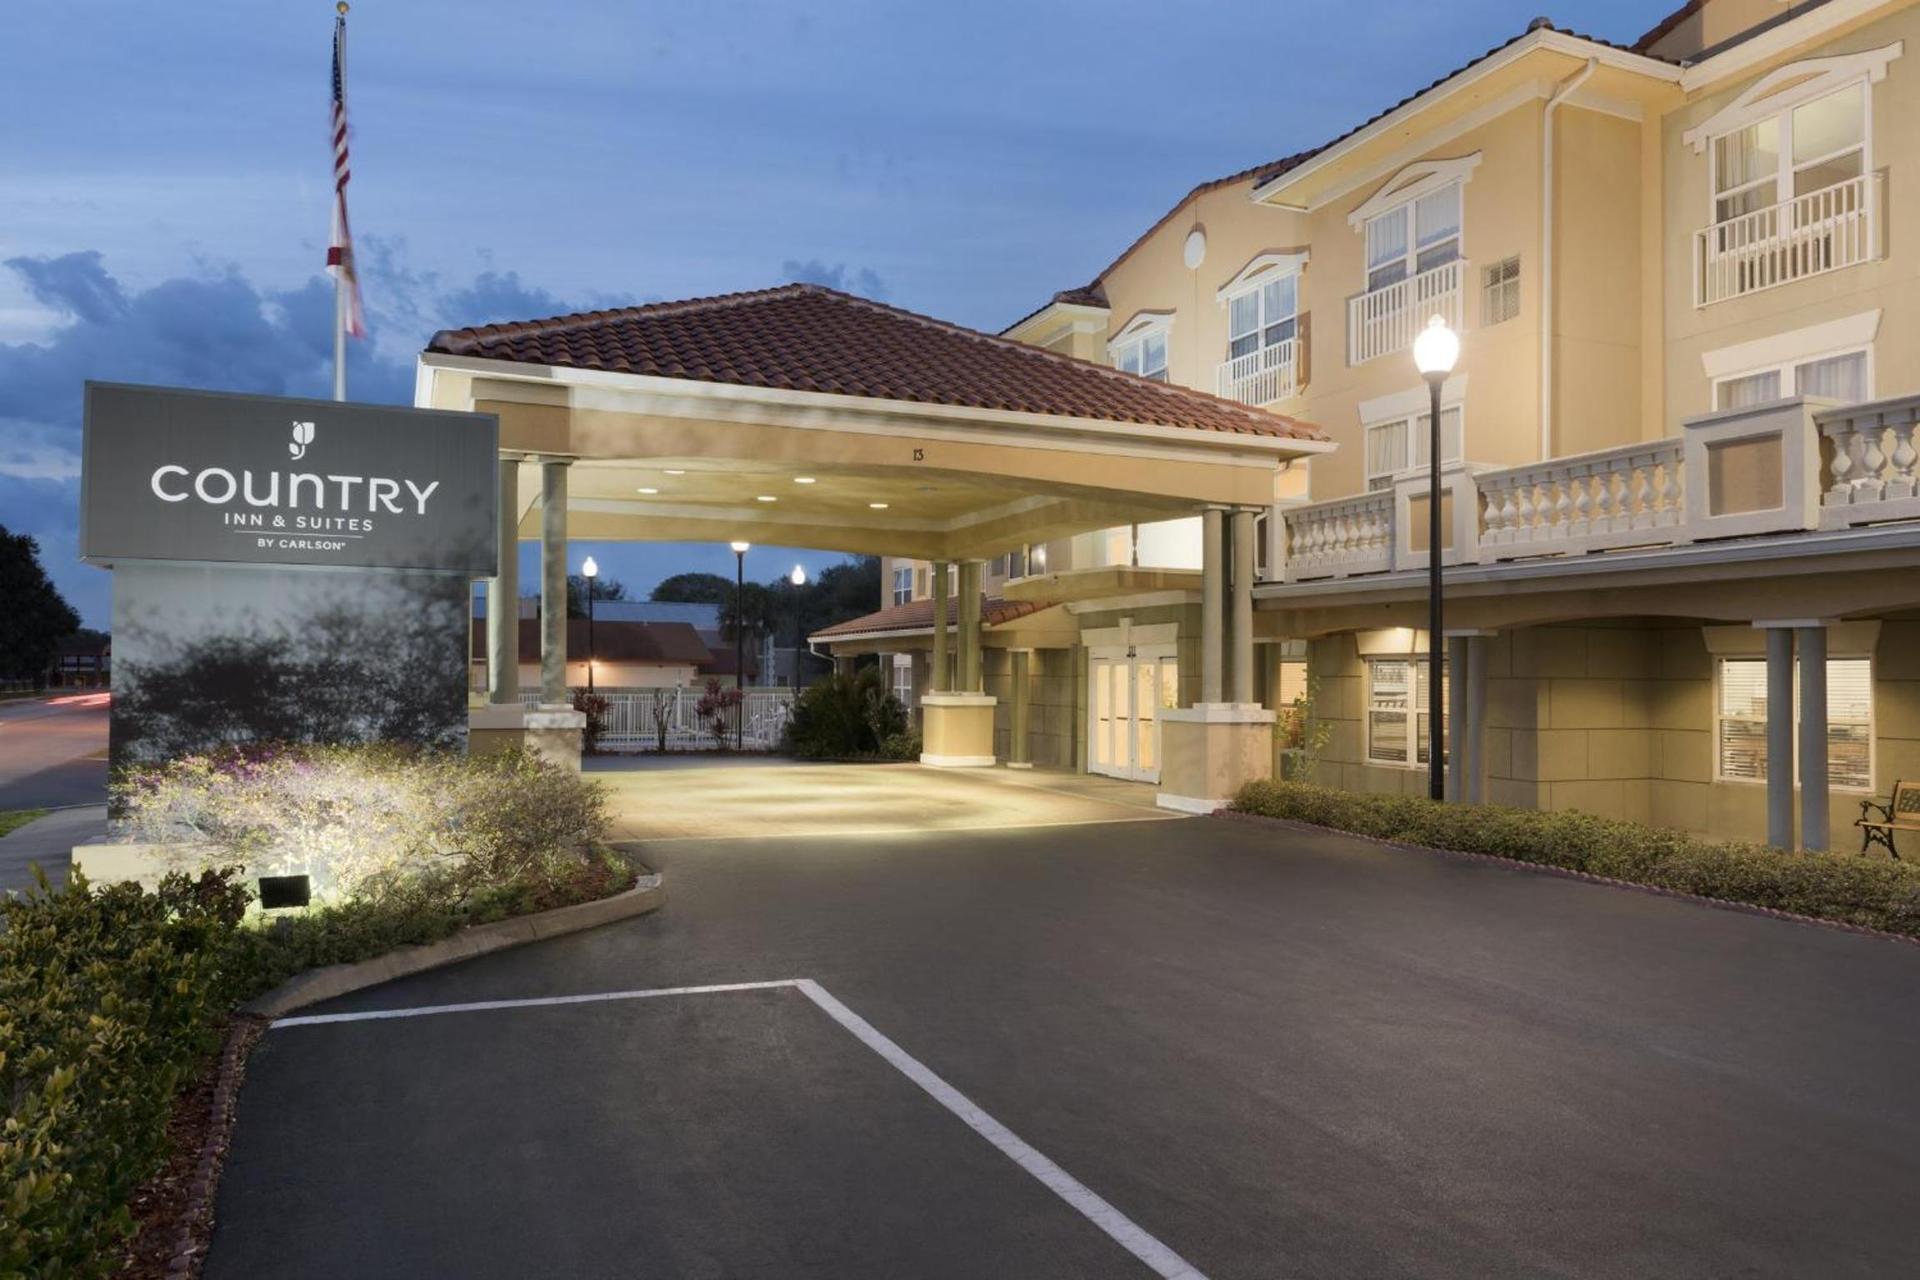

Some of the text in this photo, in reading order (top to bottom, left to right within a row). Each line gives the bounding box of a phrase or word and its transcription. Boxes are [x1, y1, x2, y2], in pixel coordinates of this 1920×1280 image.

[224, 512, 374, 532] INN & SUITES
[257, 538, 275, 548] BY
